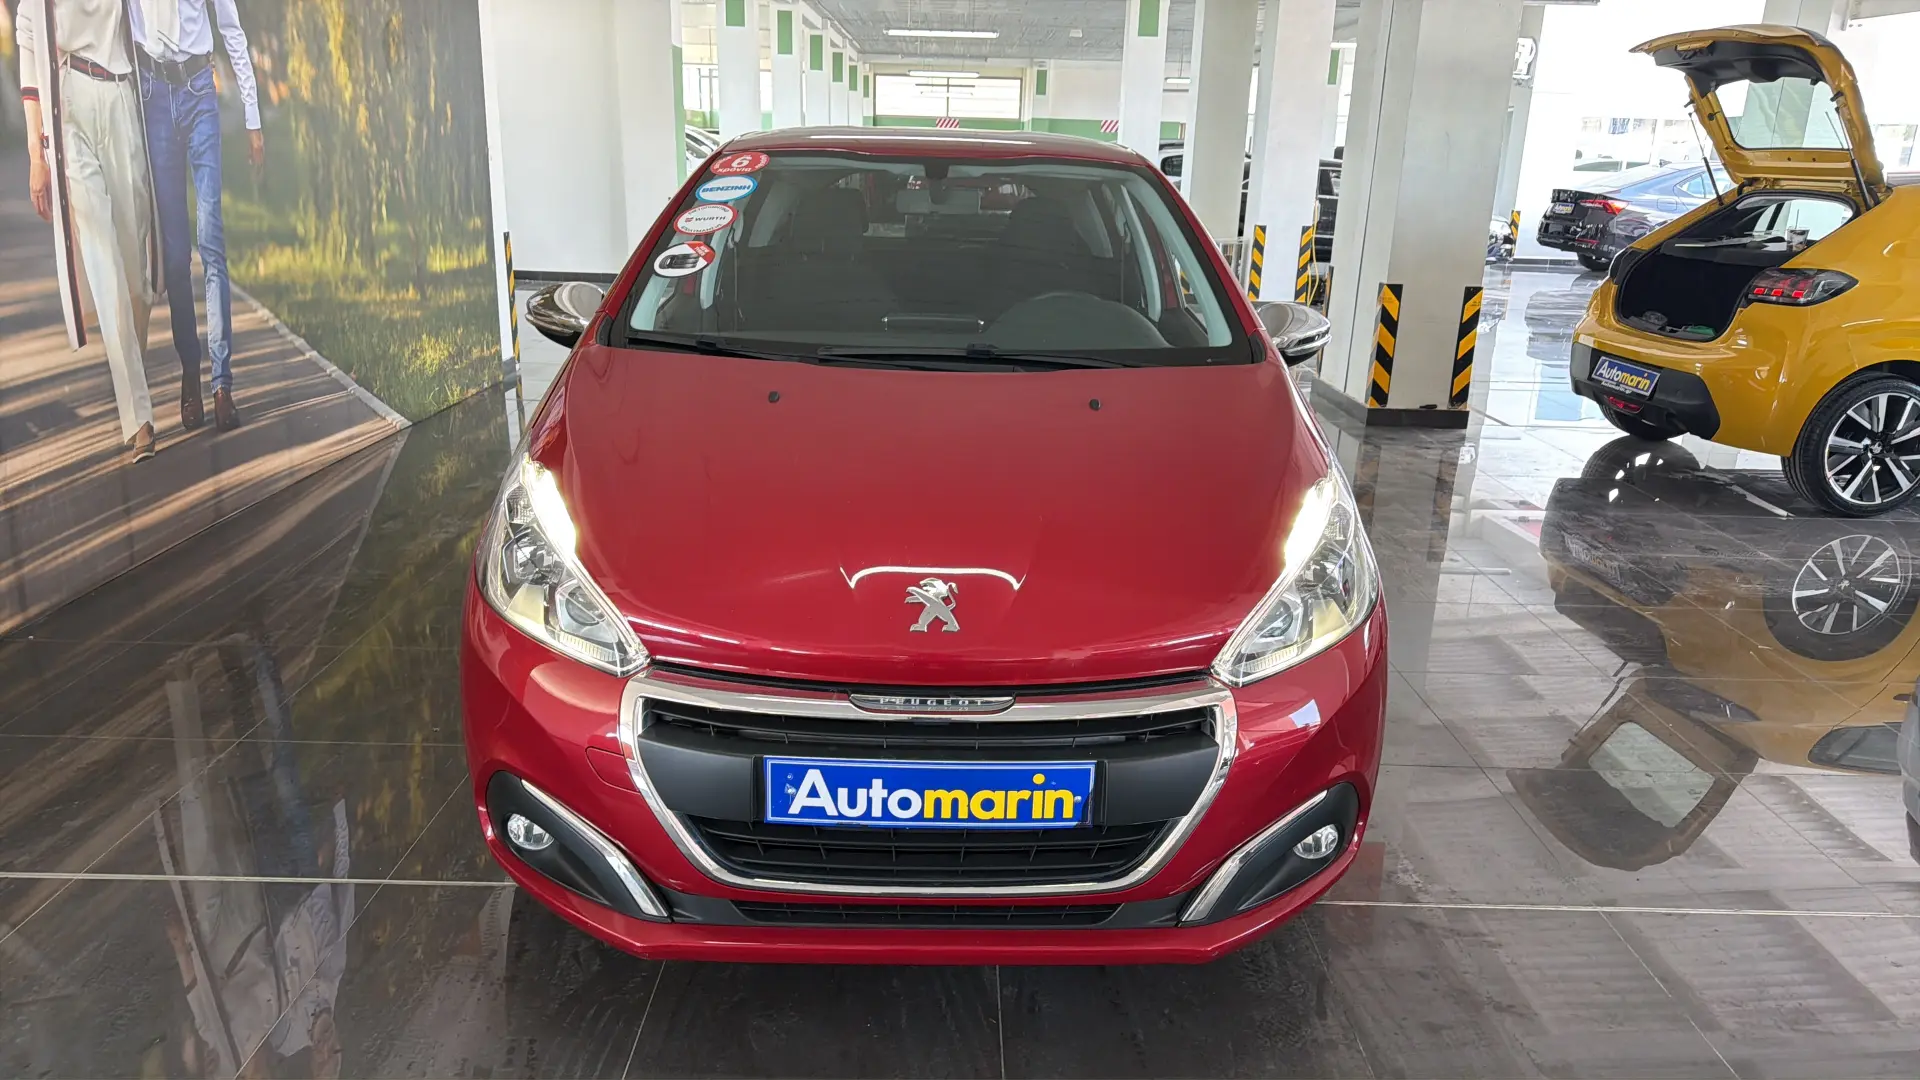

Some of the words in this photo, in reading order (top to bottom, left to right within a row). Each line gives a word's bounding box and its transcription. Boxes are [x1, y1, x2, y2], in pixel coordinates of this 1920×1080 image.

[731, 155, 752, 168] 6
[1597, 361, 1651, 391] Automarin
[880, 698, 987, 706] PEUGEOT
[788, 768, 1075, 820] Automarin
